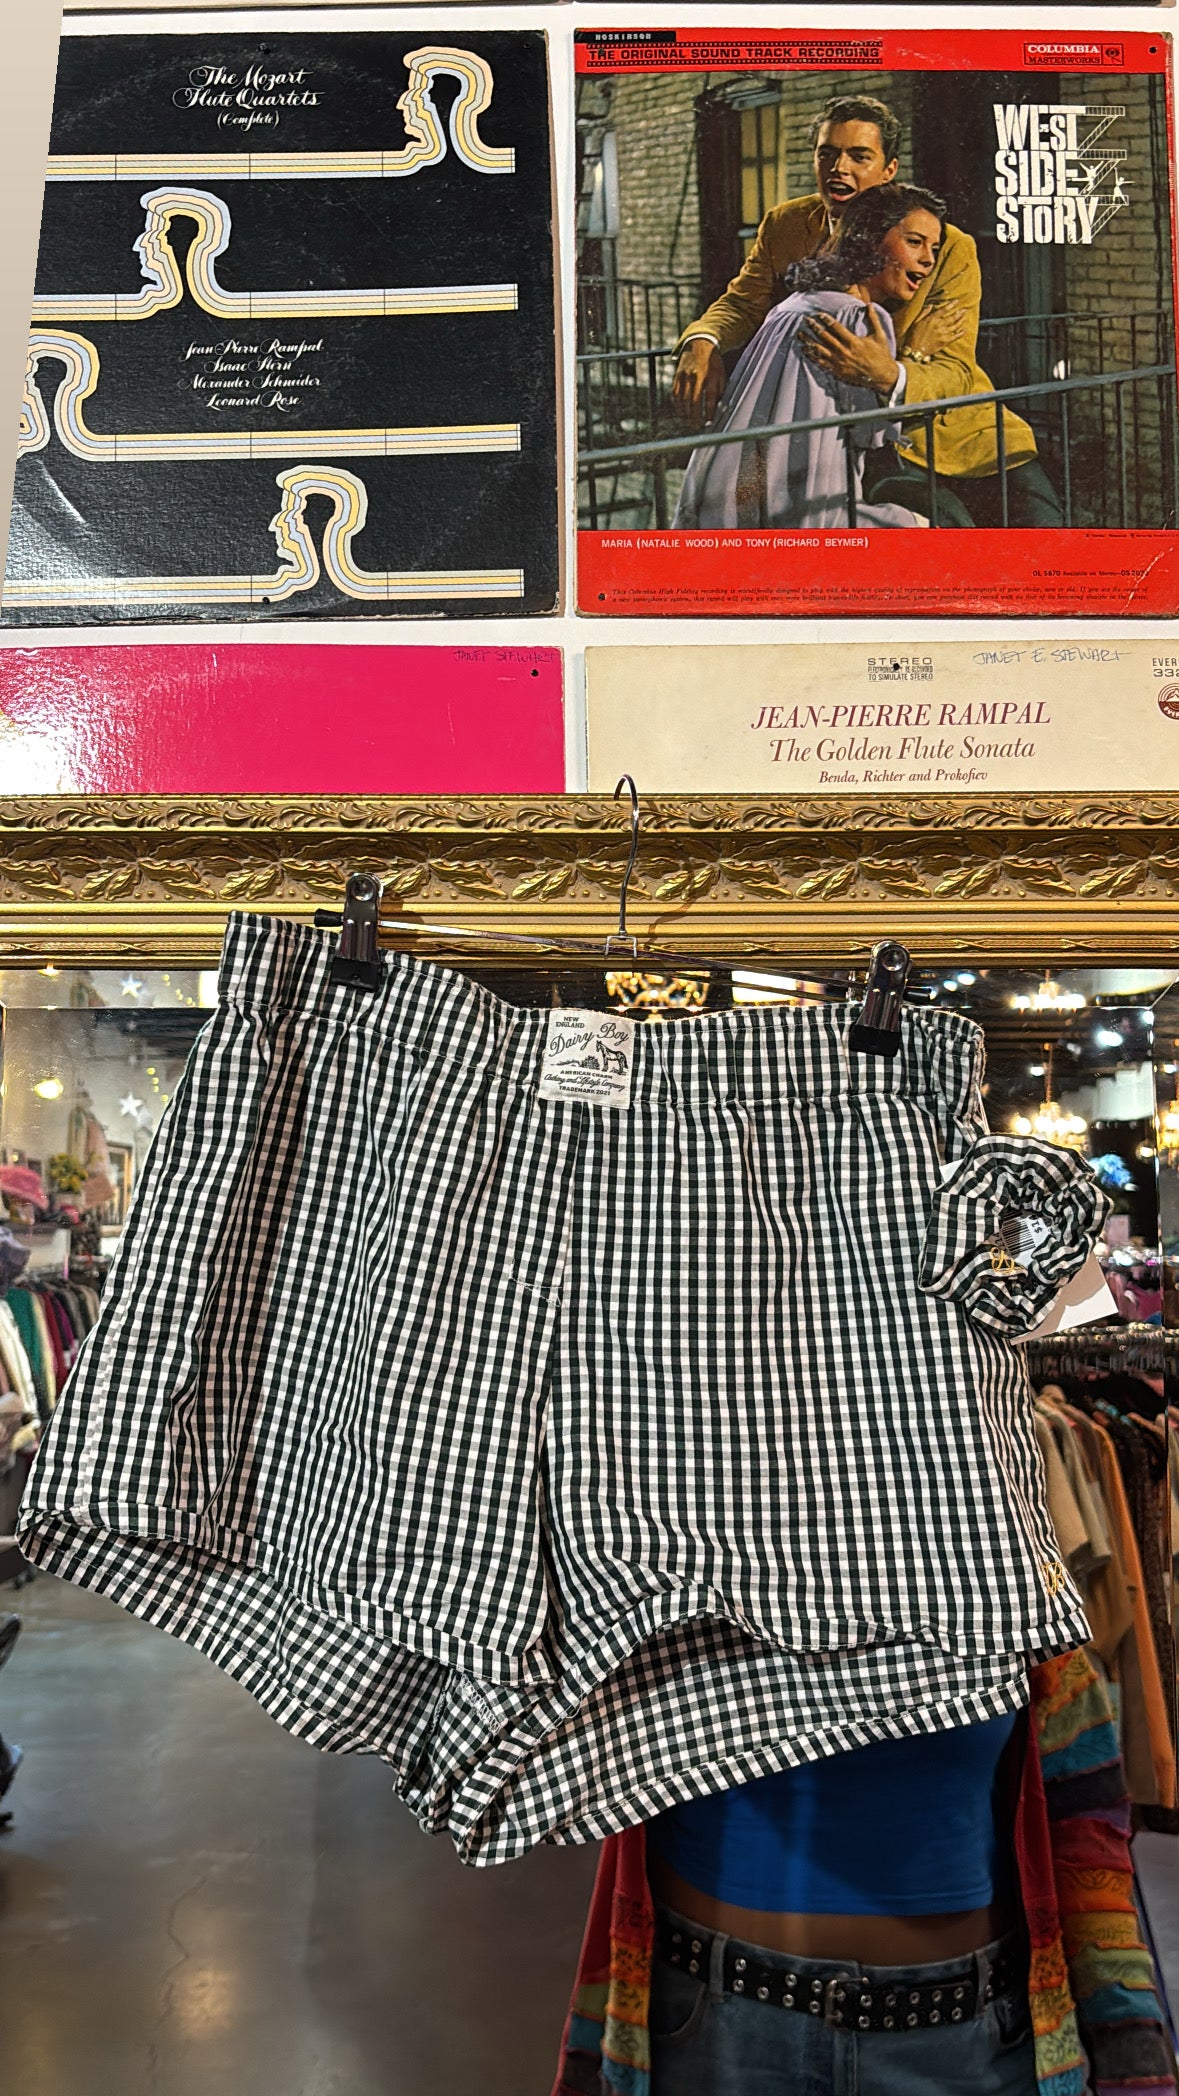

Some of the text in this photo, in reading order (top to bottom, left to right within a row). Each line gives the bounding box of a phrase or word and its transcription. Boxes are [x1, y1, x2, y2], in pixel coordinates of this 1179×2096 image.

[589, 47, 879, 60] THE ORIGINAL SOUND TRACK RECORDING
[1028, 45, 1100, 53] COLUMBIA
[1028, 56, 1100, 64] MASTERWORKS
[189, 64, 313, 91] The Mozart
[172, 87, 326, 109] Flute Quartets
[217, 110, 280, 132] (Complete)
[993, 104, 1086, 151] WEST
[995, 150, 1079, 196] SIDE
[996, 196, 1099, 244] STORY
[260, 338, 324, 362] Rampal
[204, 355, 292, 373] Isaac Stern
[177, 371, 321, 390] Alexander Schneider
[206, 391, 302, 413] Leonard Rose
[602, 537, 869, 549] MARIA (NATALIE WOOD) AND TONY (RICHARD BEYMER)
[867, 657, 932, 666] STEREO
[973, 647, 1132, 665] JANET E. STEWART
[1152, 657, 1179, 667] EVER
[868, 673, 877, 681] TO
[878, 673, 908, 681] SIMULATE
[750, 701, 1051, 730] JEAN-PIERRE RAMPAL
[769, 735, 1036, 762] The Golden Flute Sonata
[818, 768, 988, 785] Benda, Richter and Prokofiev
[555, 1021, 585, 1029] ENGLAND
[548, 1022, 630, 1057] Dairy Boy
[560, 1069, 592, 1077] AMERICAN
[559, 1085, 596, 1095] TRADEMARK
[601, 1079, 626, 1093] Company
